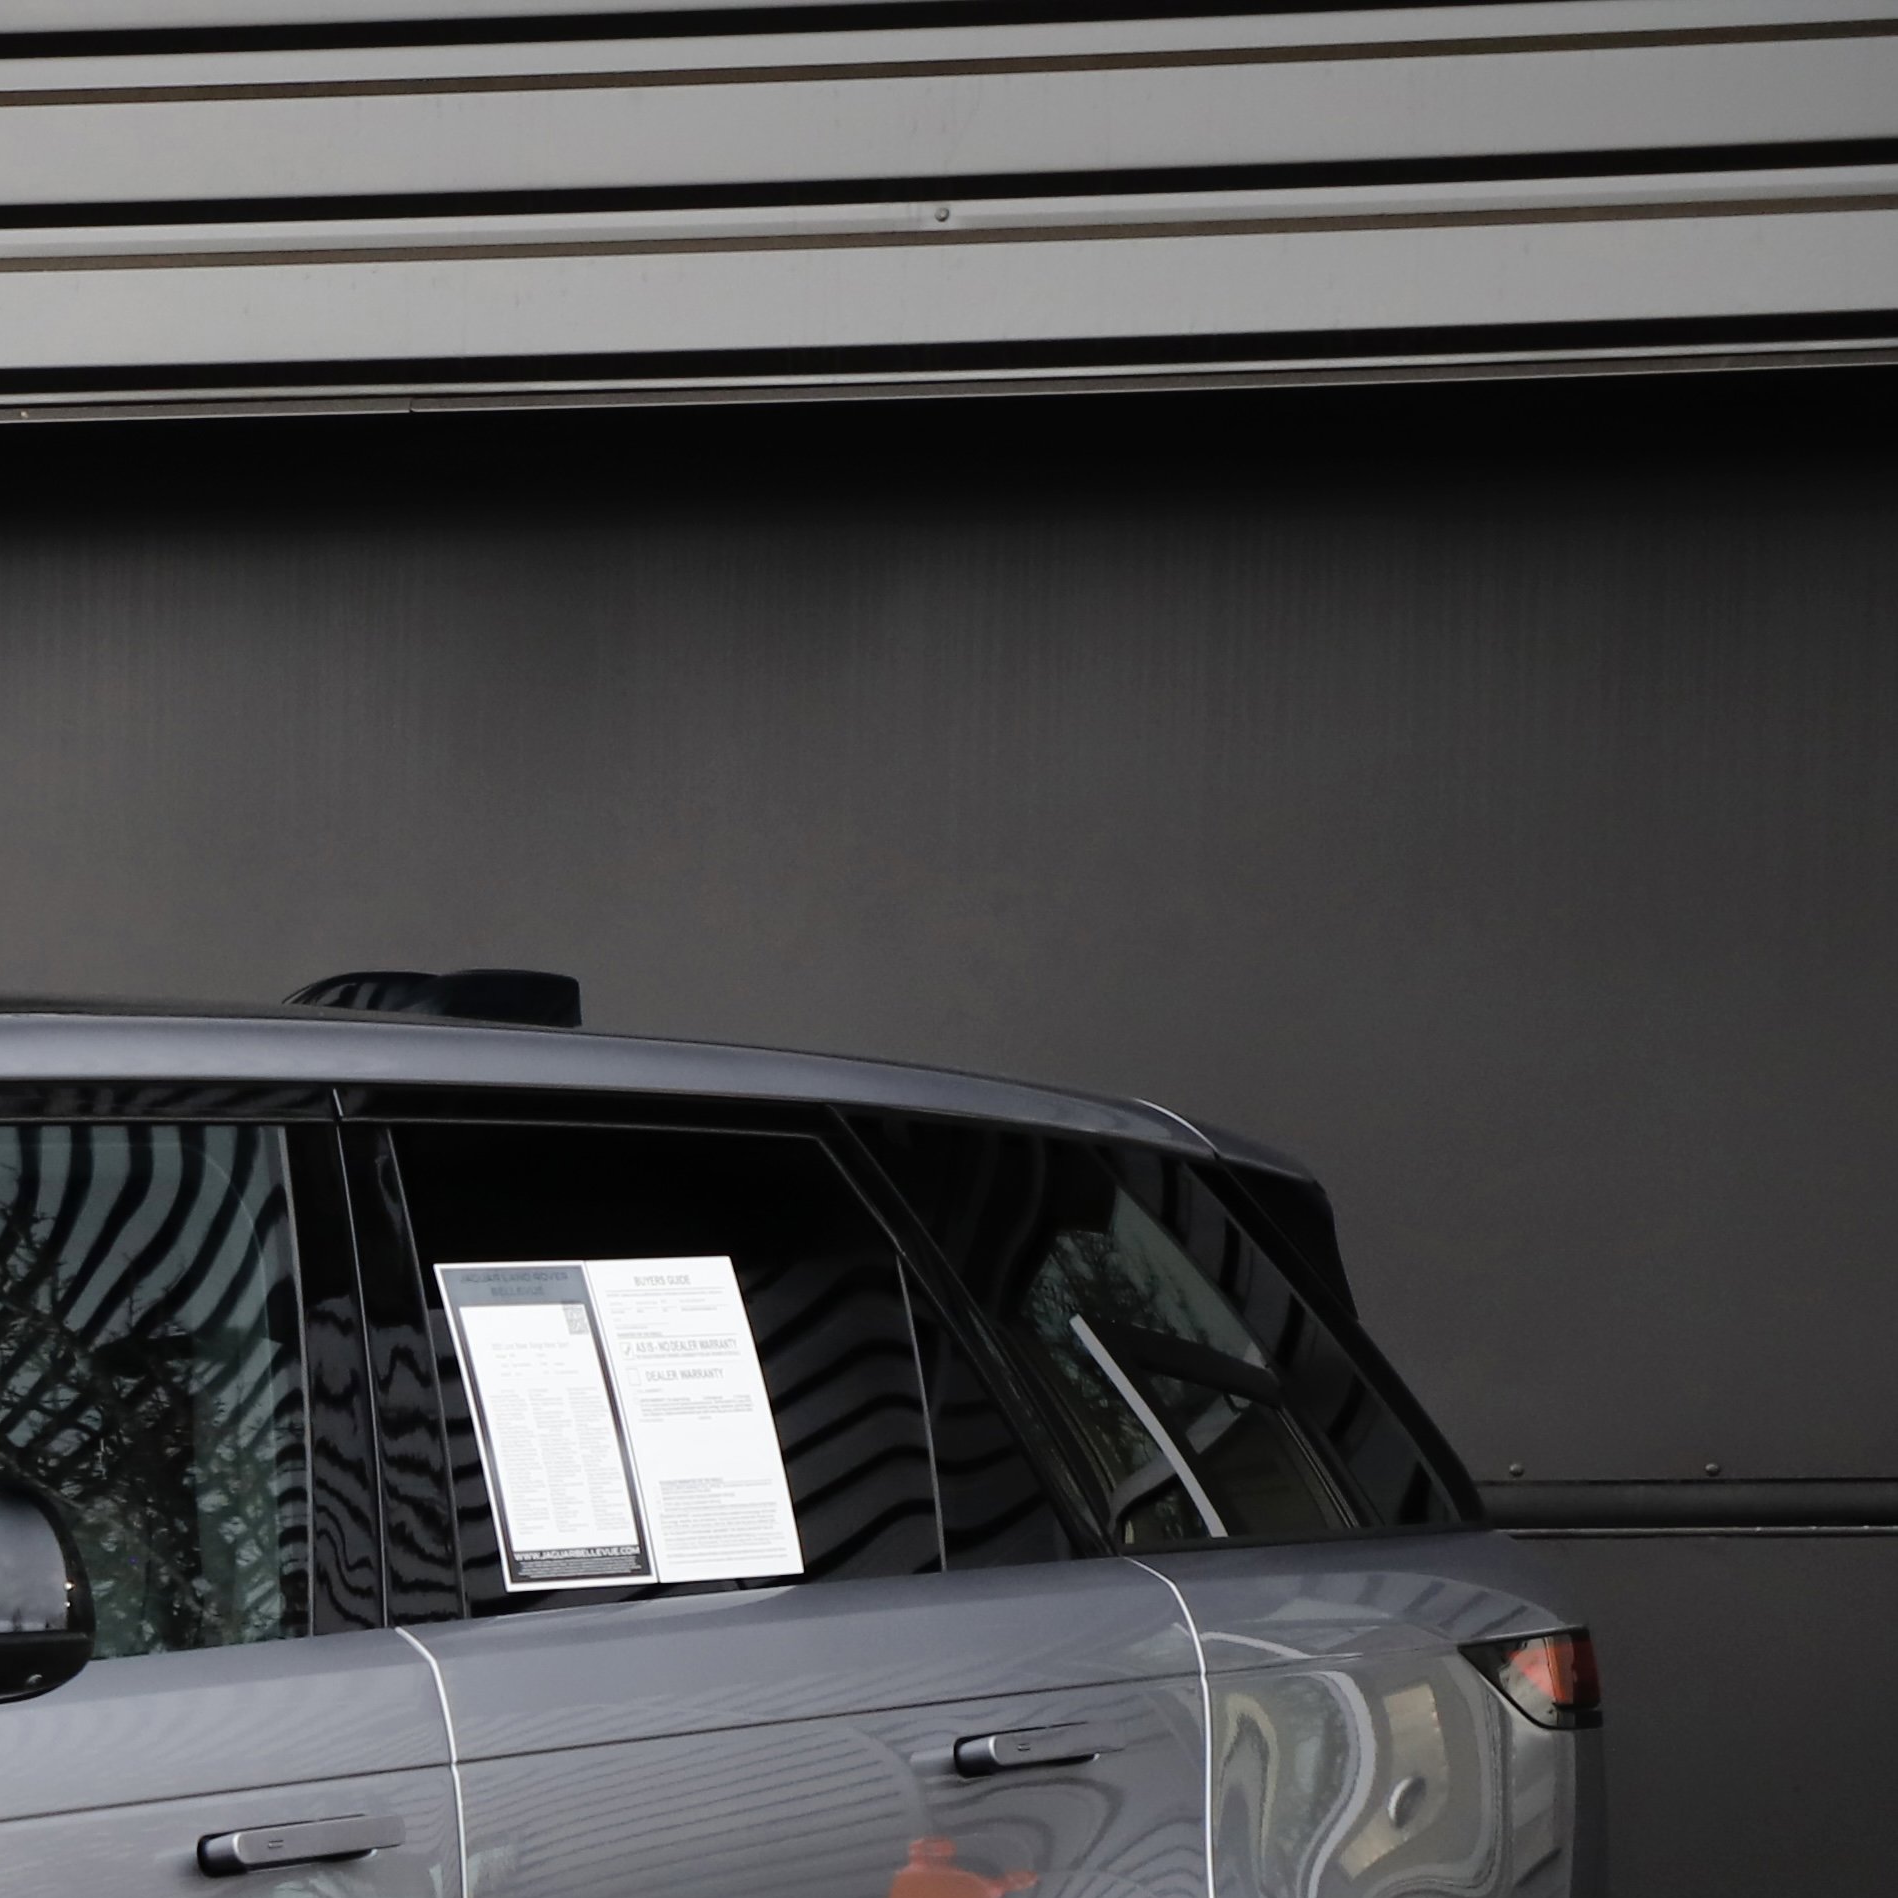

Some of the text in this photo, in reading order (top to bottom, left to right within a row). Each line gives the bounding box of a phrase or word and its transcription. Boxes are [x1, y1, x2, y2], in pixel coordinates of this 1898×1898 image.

[699, 1338, 737, 1350] WARRANTY
[645, 1367, 724, 1382] DEALER WARRANTY
